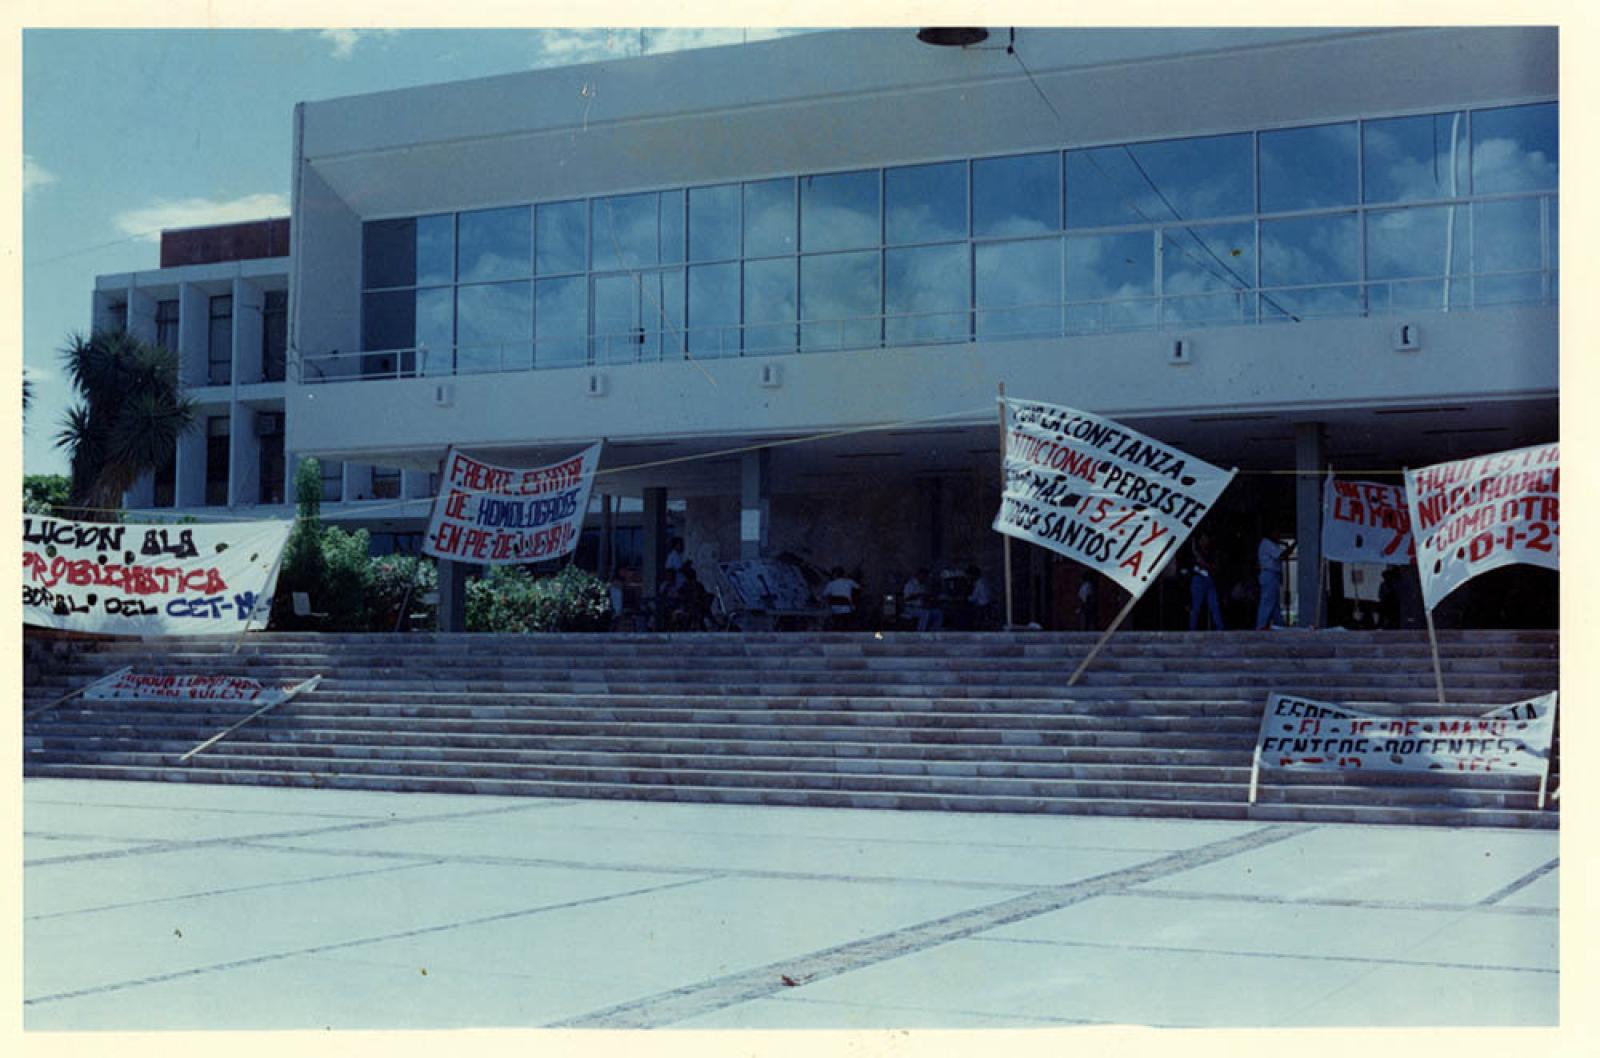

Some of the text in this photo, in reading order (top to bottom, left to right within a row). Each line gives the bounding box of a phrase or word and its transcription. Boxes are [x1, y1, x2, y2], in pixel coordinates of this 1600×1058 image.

[1062, 415, 1187, 480] CONFIANZA
[450, 454, 515, 496] FRENTE
[445, 488, 473, 521] DE
[1102, 466, 1208, 528] PERSISTE
[434, 522, 463, 553] EN
[461, 527, 493, 559] PIE
[1037, 511, 1119, 563] SANTOS
[104, 597, 159, 617] DEL
